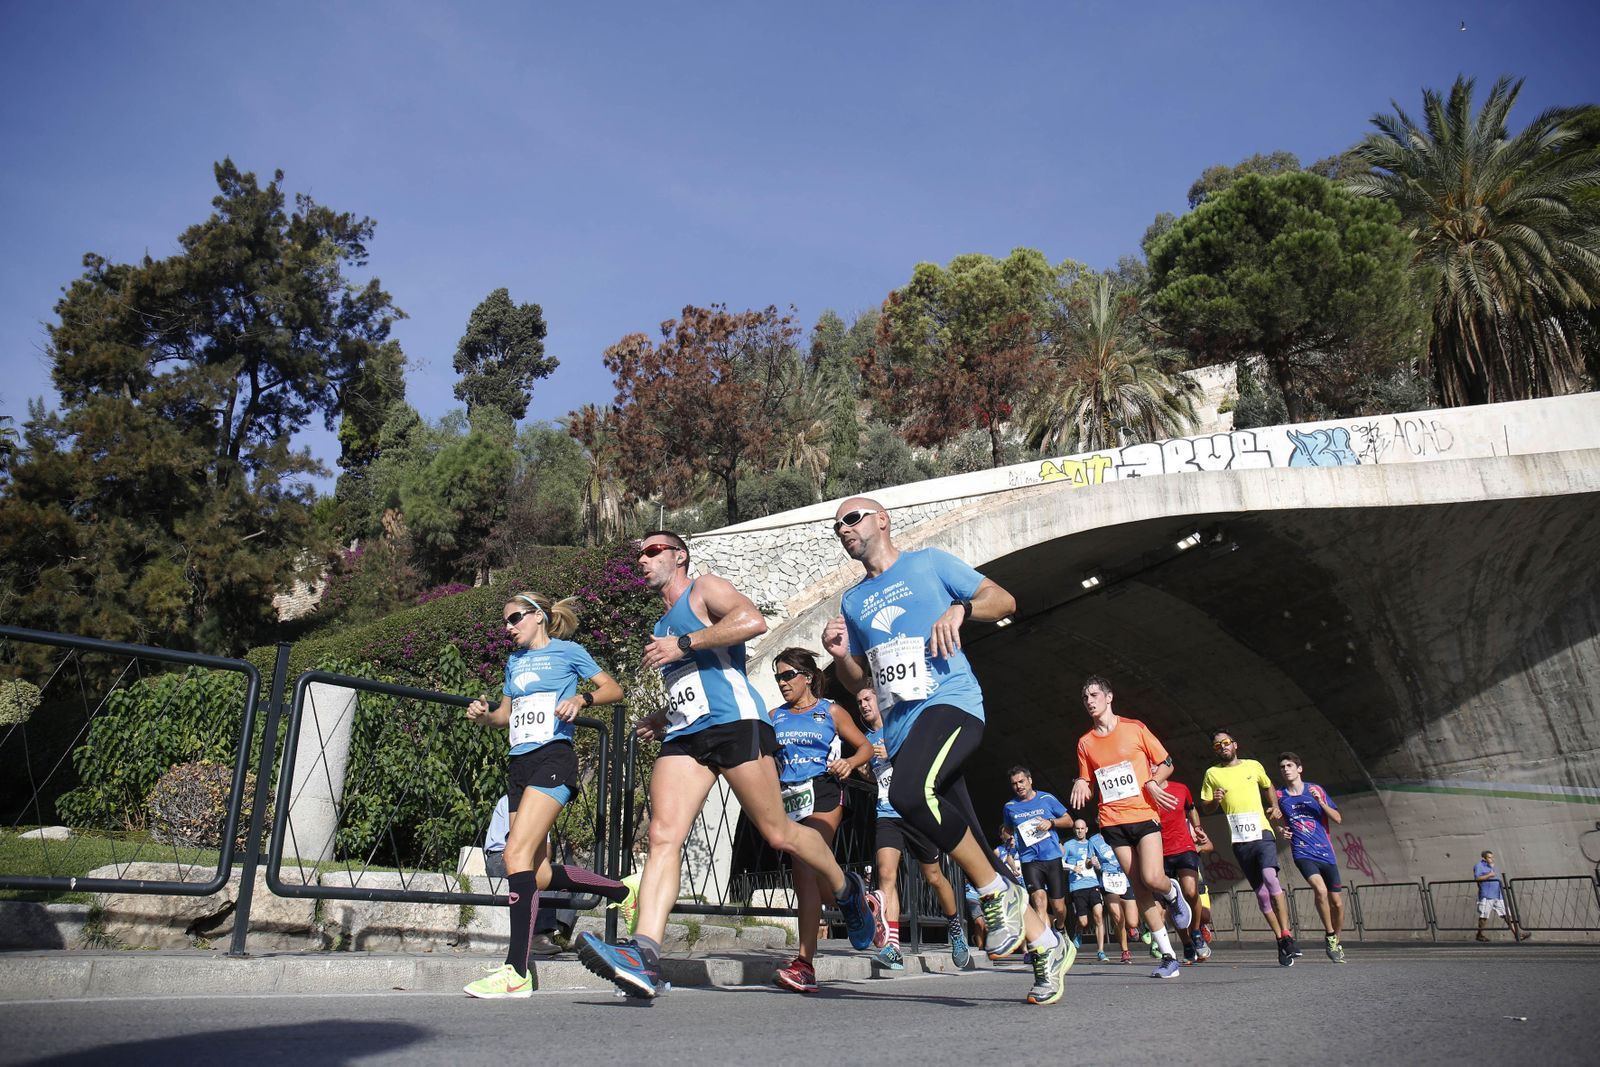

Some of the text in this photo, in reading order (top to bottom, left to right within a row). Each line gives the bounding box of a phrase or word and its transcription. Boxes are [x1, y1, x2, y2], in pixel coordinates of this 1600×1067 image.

[1392, 416, 1454, 456] ACAB
[669, 686, 695, 716] 646
[514, 711, 545, 728] 3190
[785, 731, 822, 740] DEPORTIVO
[1102, 773, 1133, 790] 13160
[1235, 823, 1256, 833] 1703
